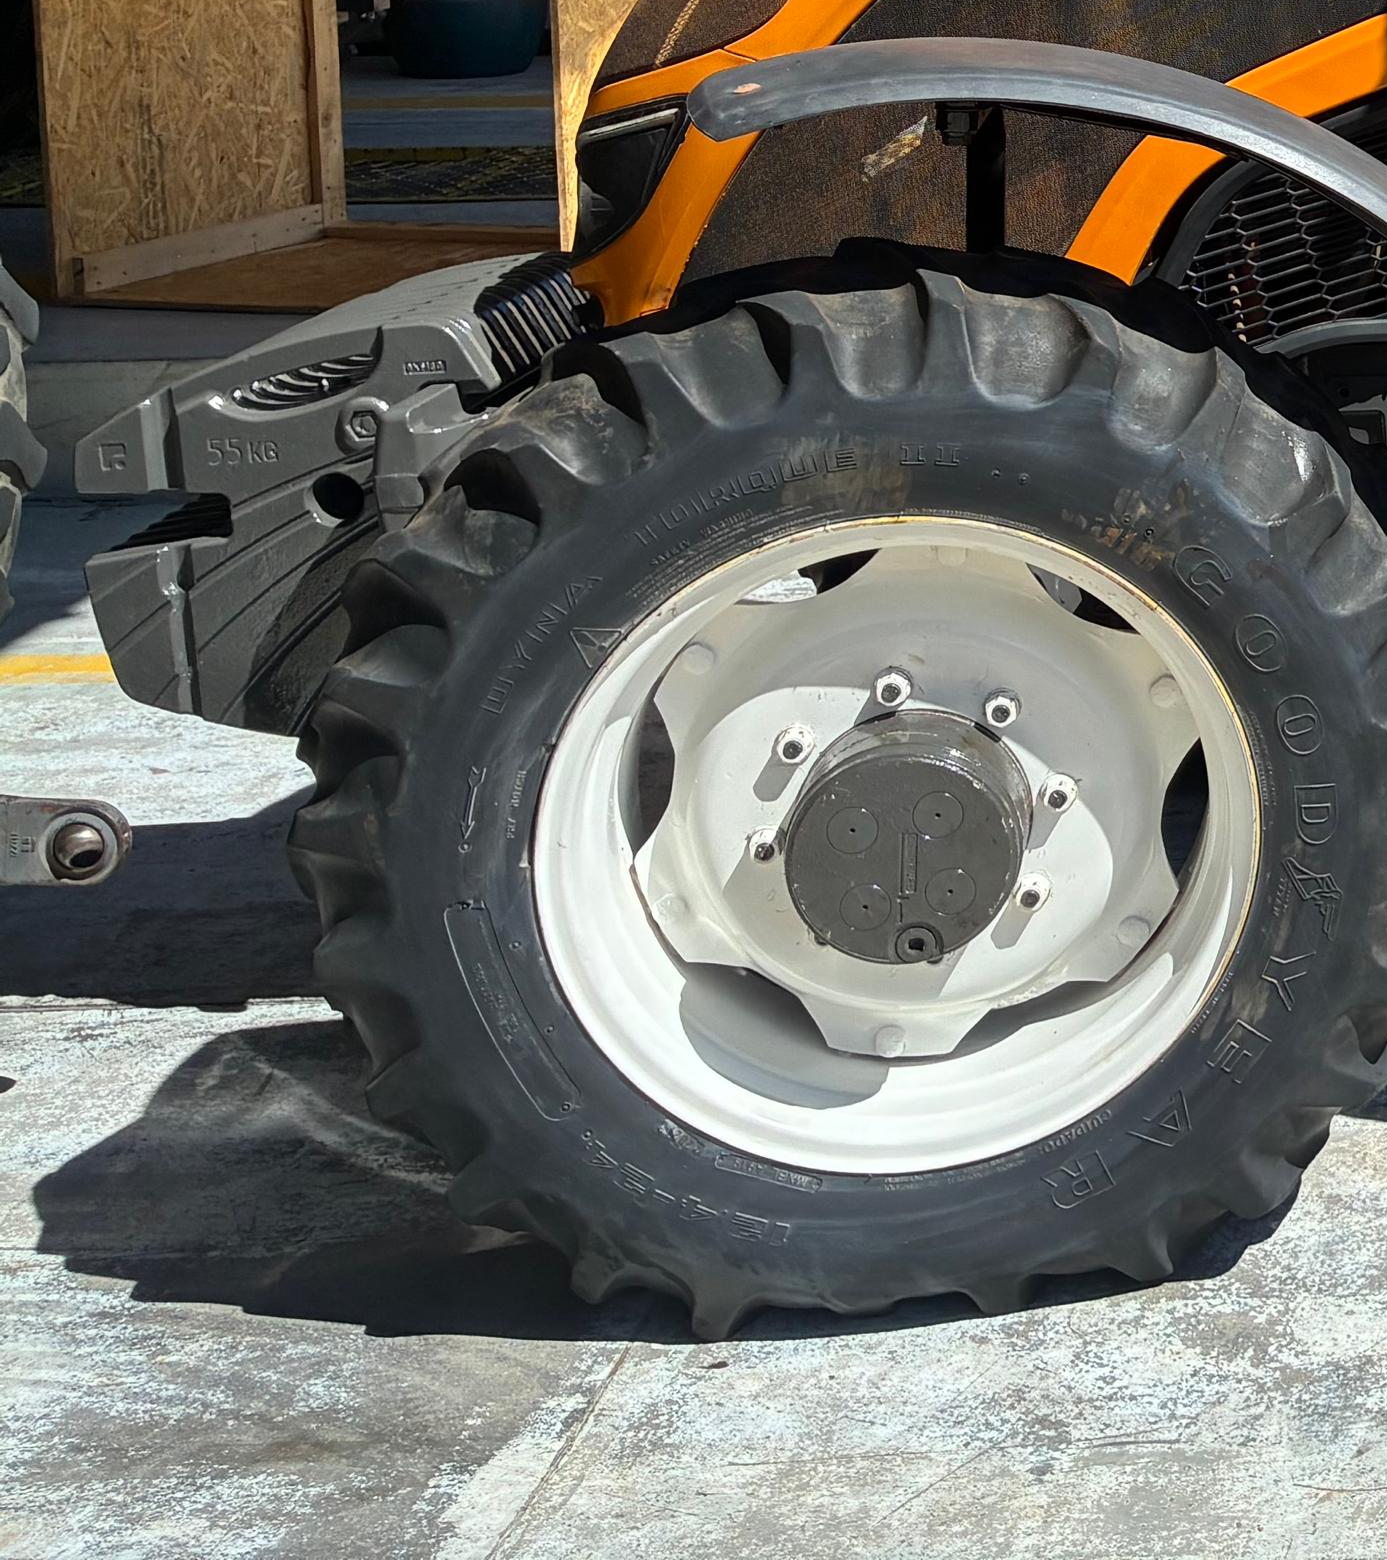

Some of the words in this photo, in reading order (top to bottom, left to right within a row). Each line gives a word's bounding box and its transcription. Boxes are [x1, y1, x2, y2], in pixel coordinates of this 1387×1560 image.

[206, 438, 243, 467] 55
[248, 441, 280, 465] KG
[480, 574, 602, 716] DYNA
[629, 447, 858, 546] TORQUE
[1040, 544, 1339, 1211] GOODYEAR
